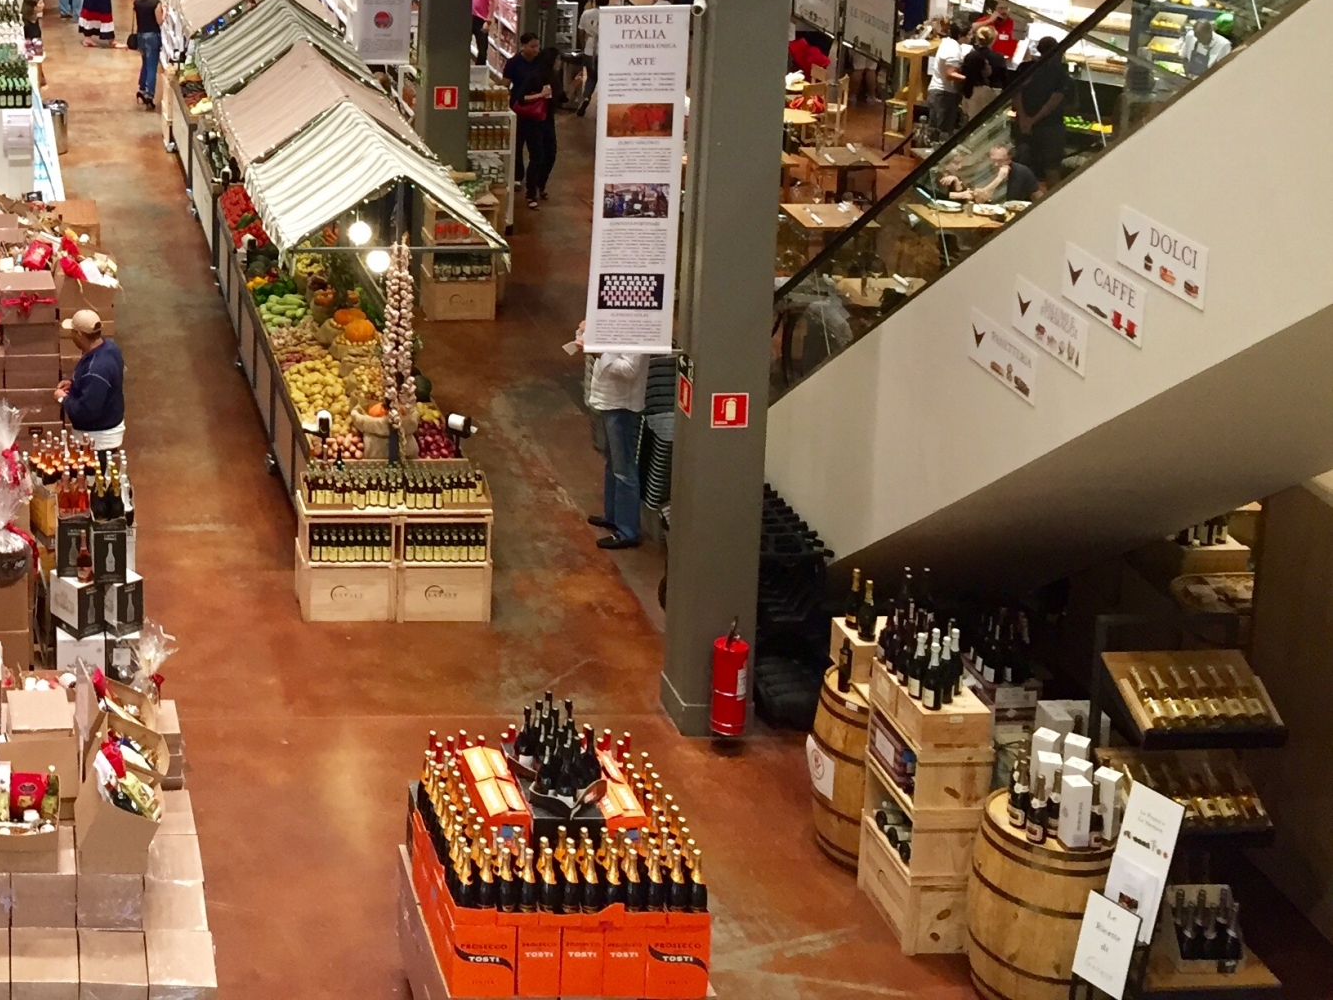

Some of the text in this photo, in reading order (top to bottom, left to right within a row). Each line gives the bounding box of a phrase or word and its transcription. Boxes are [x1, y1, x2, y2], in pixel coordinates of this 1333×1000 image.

[615, 14, 674, 24] BRASIL E
[628, 57, 656, 66] ARTE
[1150, 227, 1198, 270] DOLCI
[1107, 911, 1117, 921] Le
[662, 955, 694, 963] TOSTI
